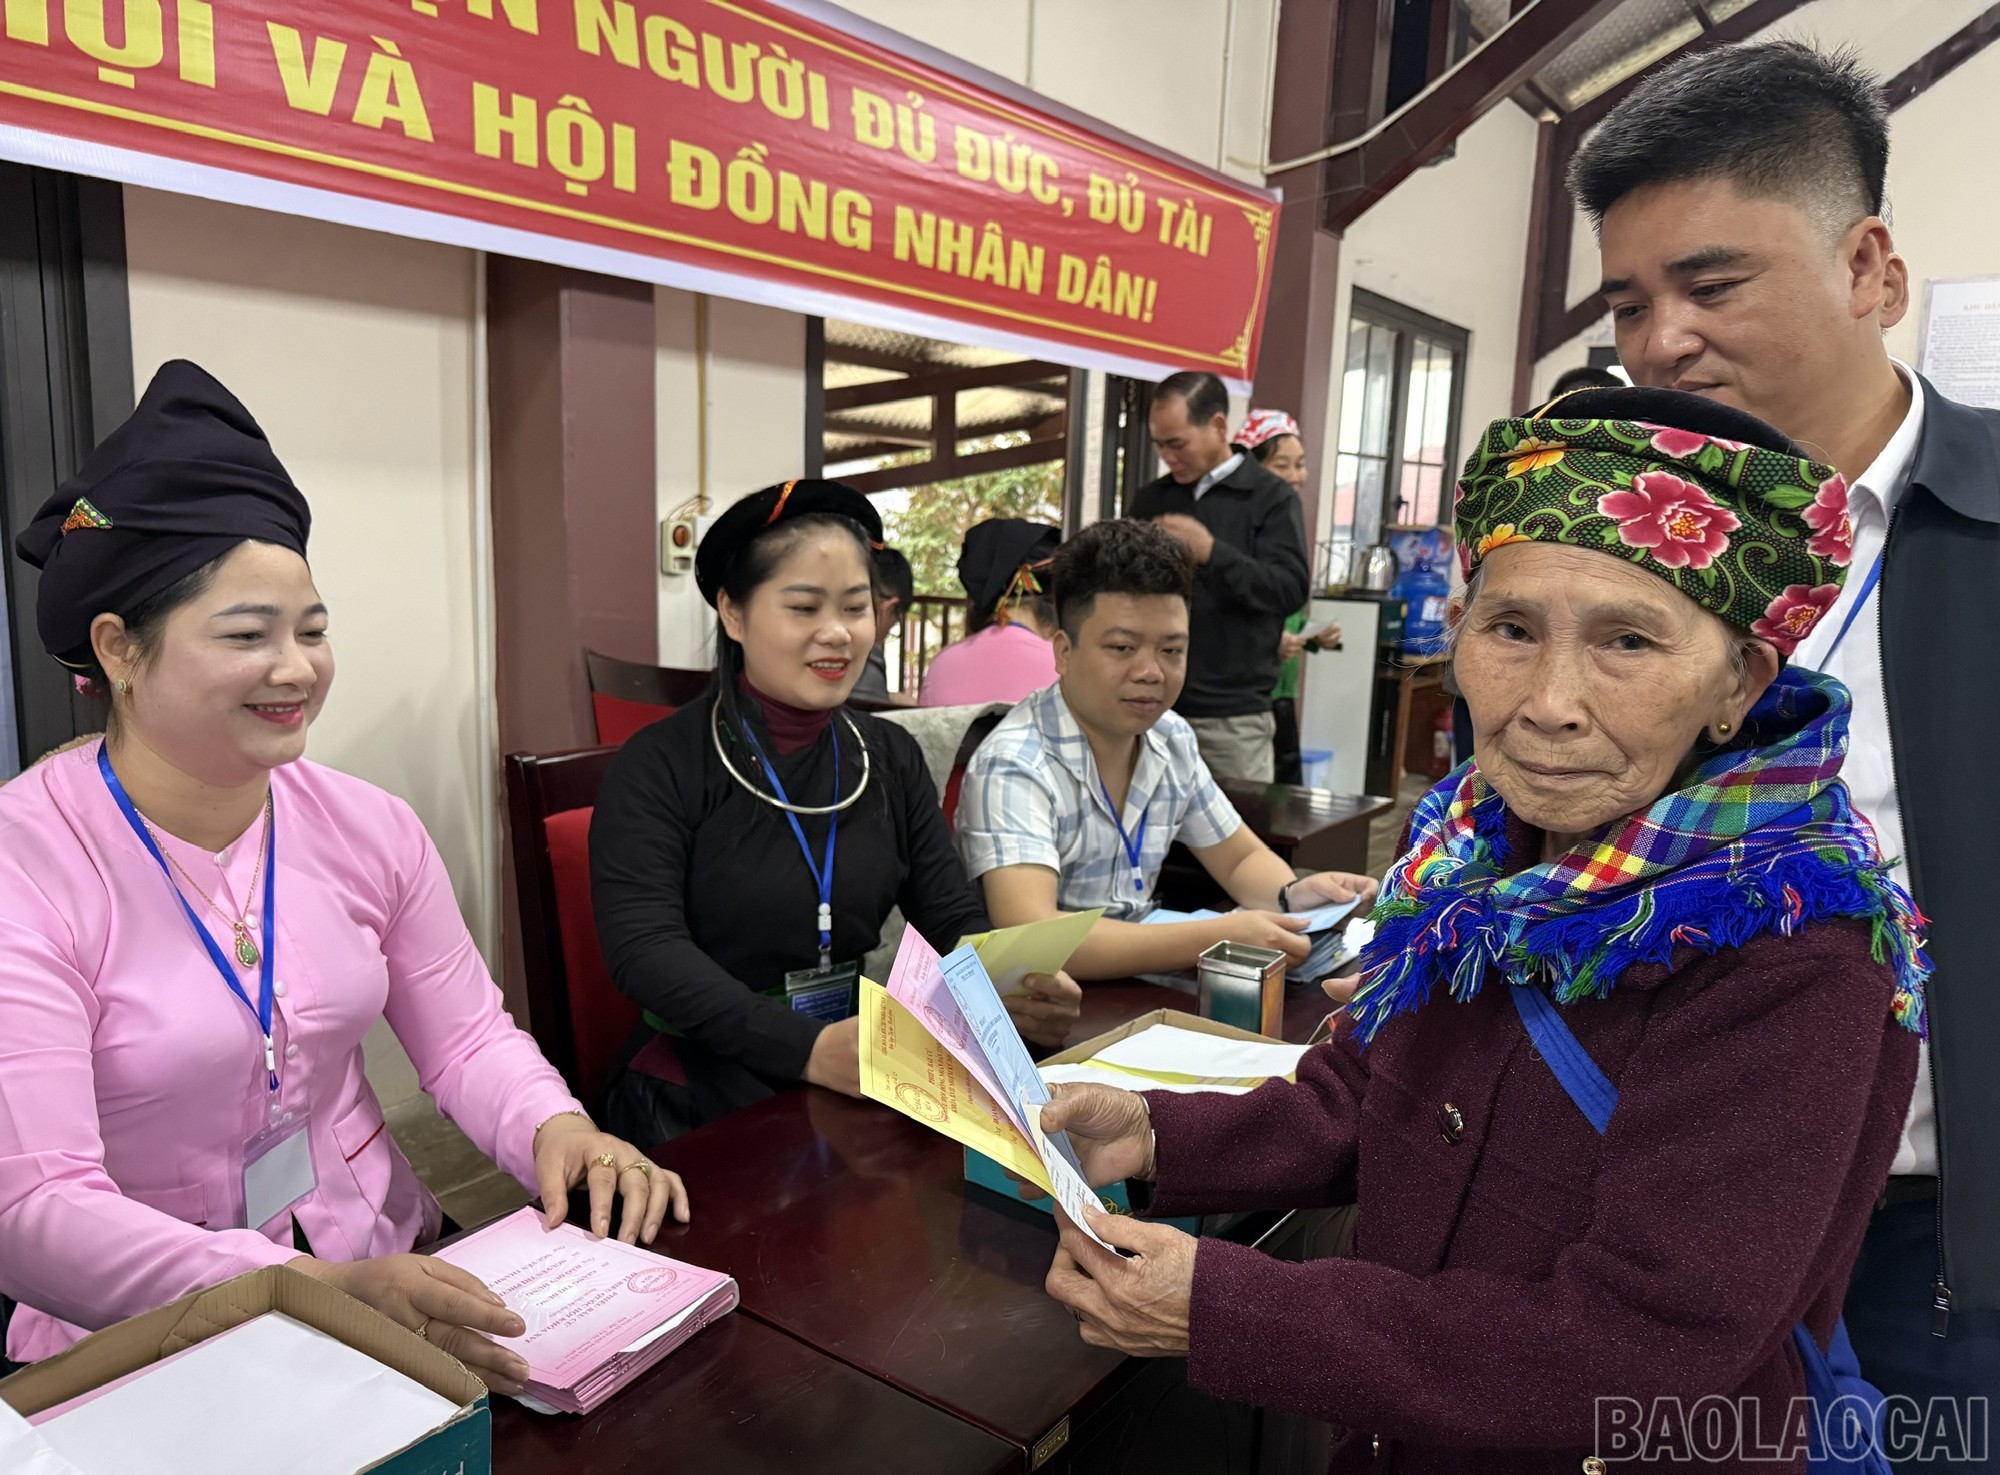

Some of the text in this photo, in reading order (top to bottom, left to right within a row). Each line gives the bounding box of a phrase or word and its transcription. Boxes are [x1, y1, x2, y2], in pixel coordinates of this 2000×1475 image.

[266, 21, 434, 143] VÀ
[472, 81, 636, 197] HỘI
[666, 138, 874, 252] ĐỒNG
[894, 204, 1045, 295] NHÂN
[1056, 253, 1159, 323] DÂN!
[573, 0, 830, 130] NGƯỜI
[850, 87, 937, 163] ĐỦ
[954, 124, 1074, 217] ĐỨC,
[1086, 171, 1147, 233] ĐỦ
[1156, 197, 1212, 257] TÀI
